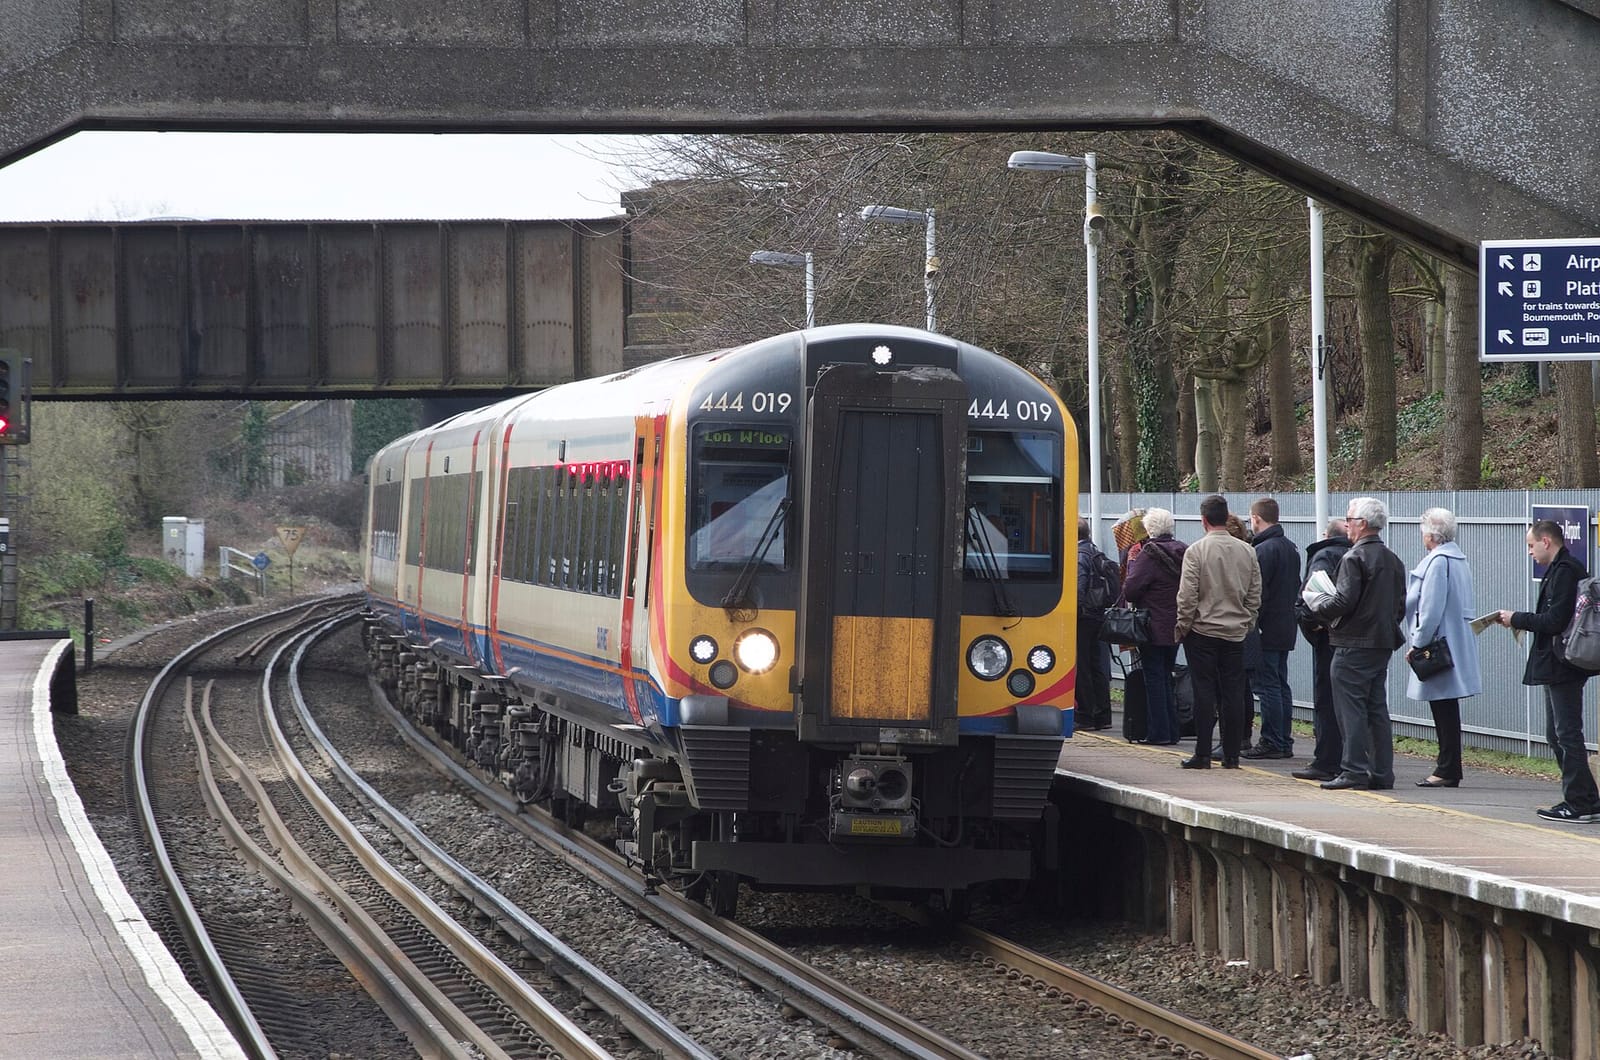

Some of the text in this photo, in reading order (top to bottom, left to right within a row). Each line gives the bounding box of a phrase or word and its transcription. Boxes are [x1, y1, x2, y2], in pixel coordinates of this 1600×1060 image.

[1566, 254, 1600, 272] Airp
[1566, 280, 1600, 296] Plat
[1523, 301, 1600, 311] for trains towards
[1587, 311, 1600, 321] Po
[699, 391, 792, 413] 444 019
[967, 398, 1052, 422] 444 019
[704, 431, 732, 443] Lon
[283, 529, 299, 541] 75
